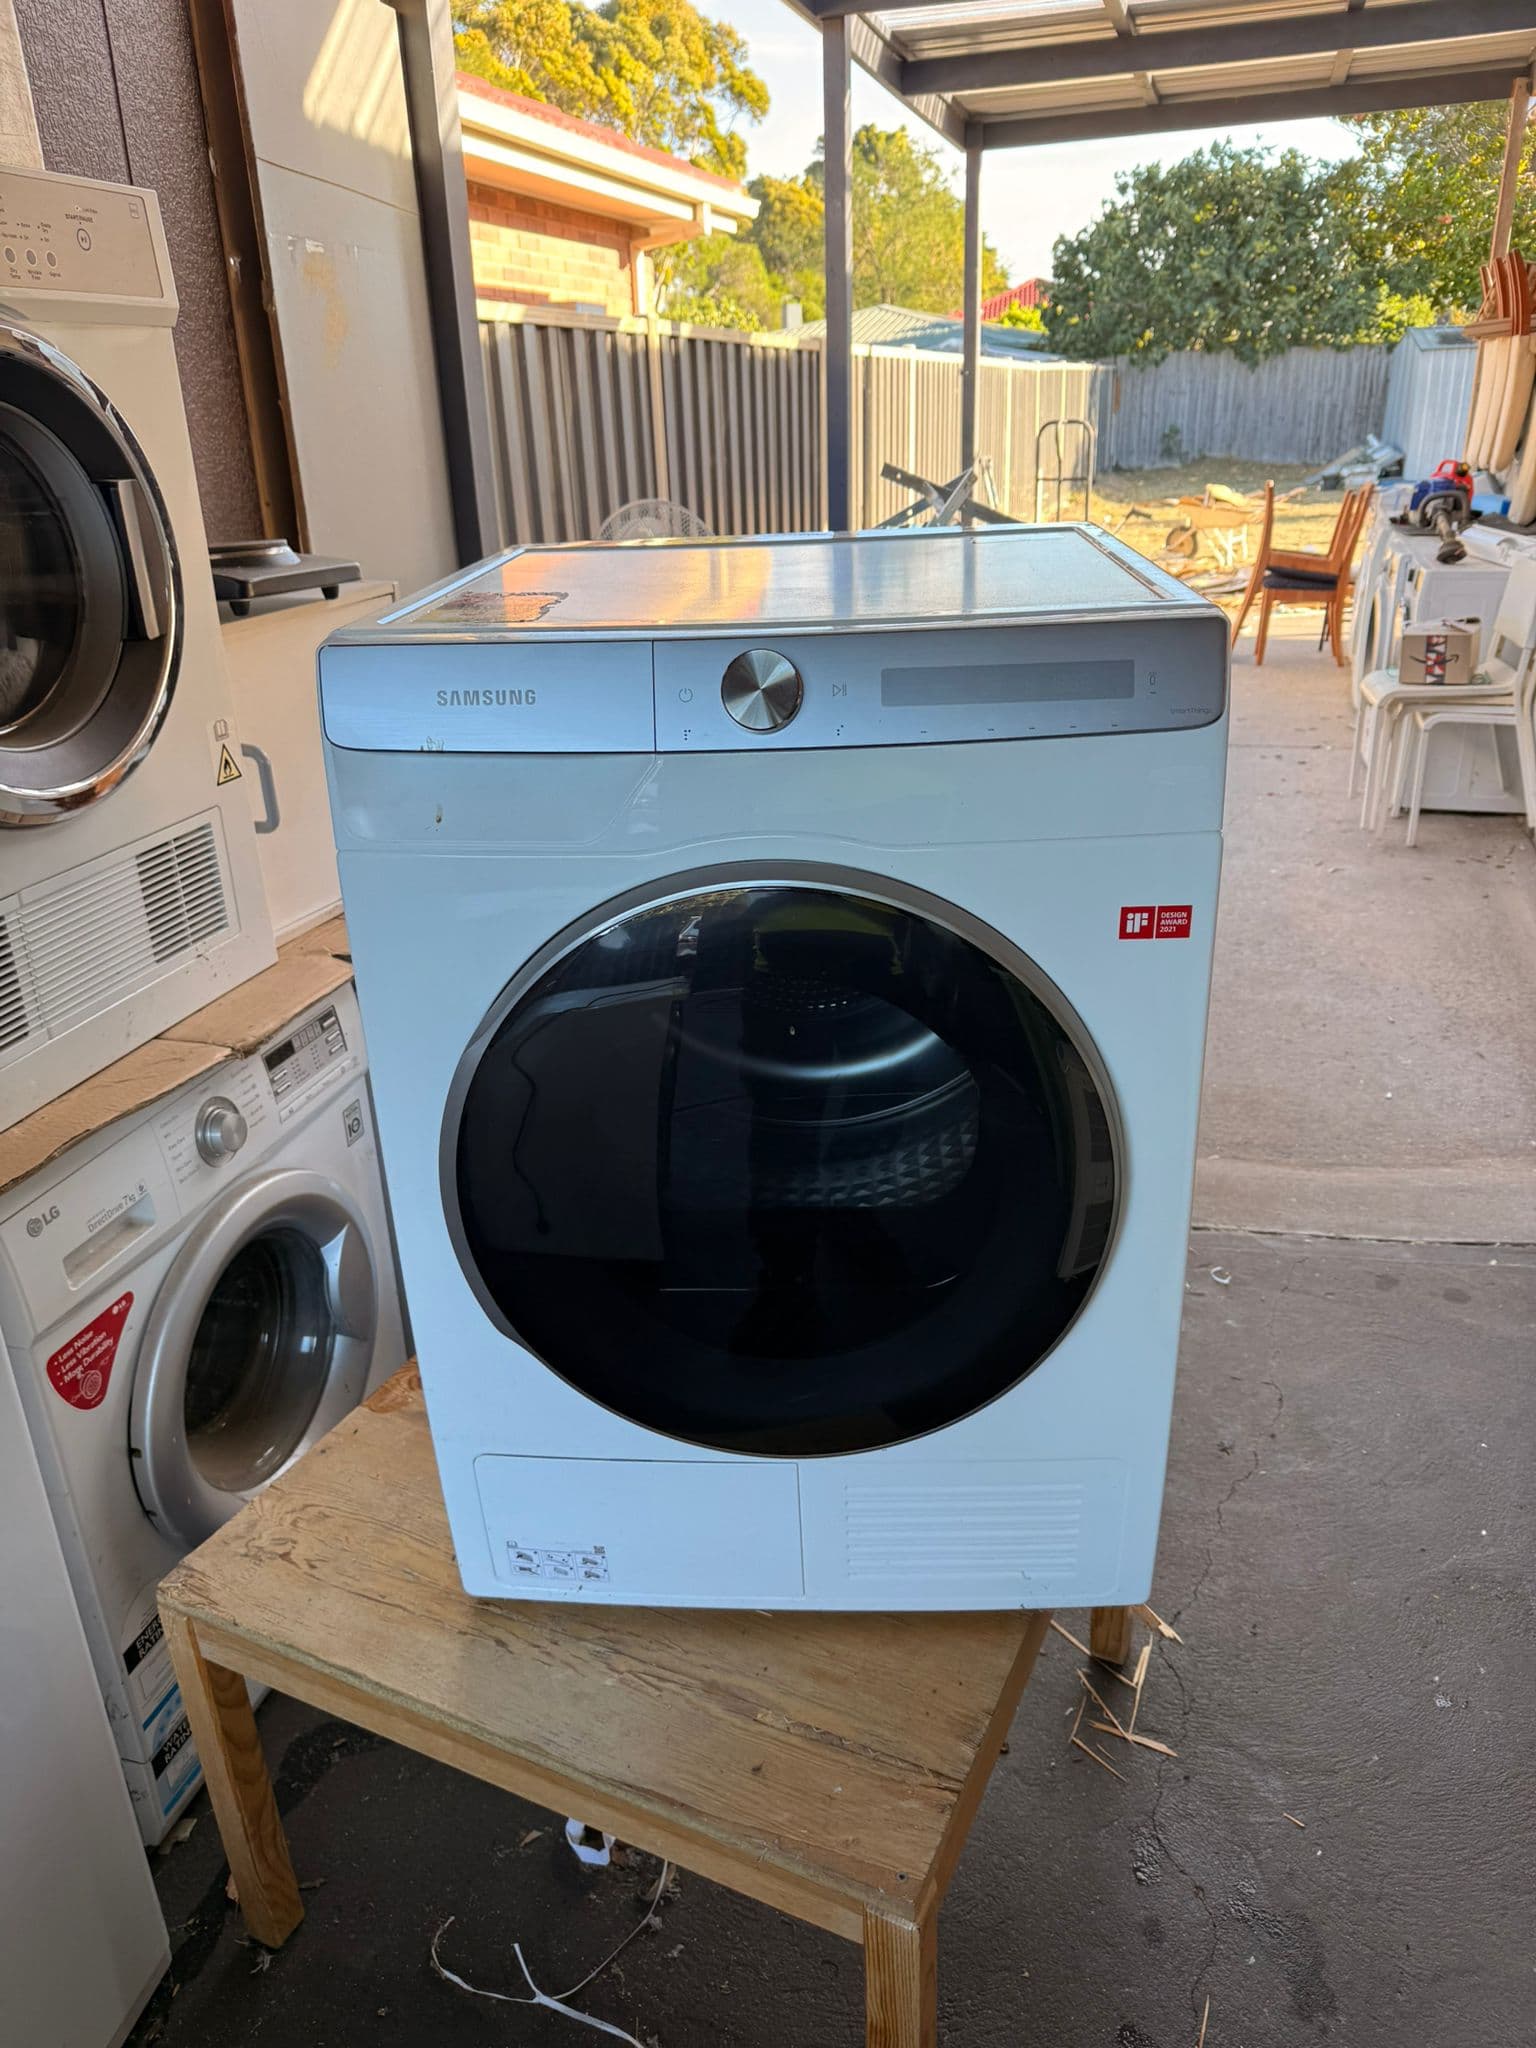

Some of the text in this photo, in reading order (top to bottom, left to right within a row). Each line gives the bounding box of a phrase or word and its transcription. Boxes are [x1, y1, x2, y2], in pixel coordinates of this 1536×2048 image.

[436, 688, 537, 706] SAMSUNG
[1125, 912, 1149, 934] iF
[1159, 918, 1188, 926] AWARD
[1160, 911, 1188, 919] DESIGN
[41, 1205, 61, 1226] LG
[58, 1330, 94, 1363] Less Noise
[60, 1331, 107, 1373] Less Vibration
